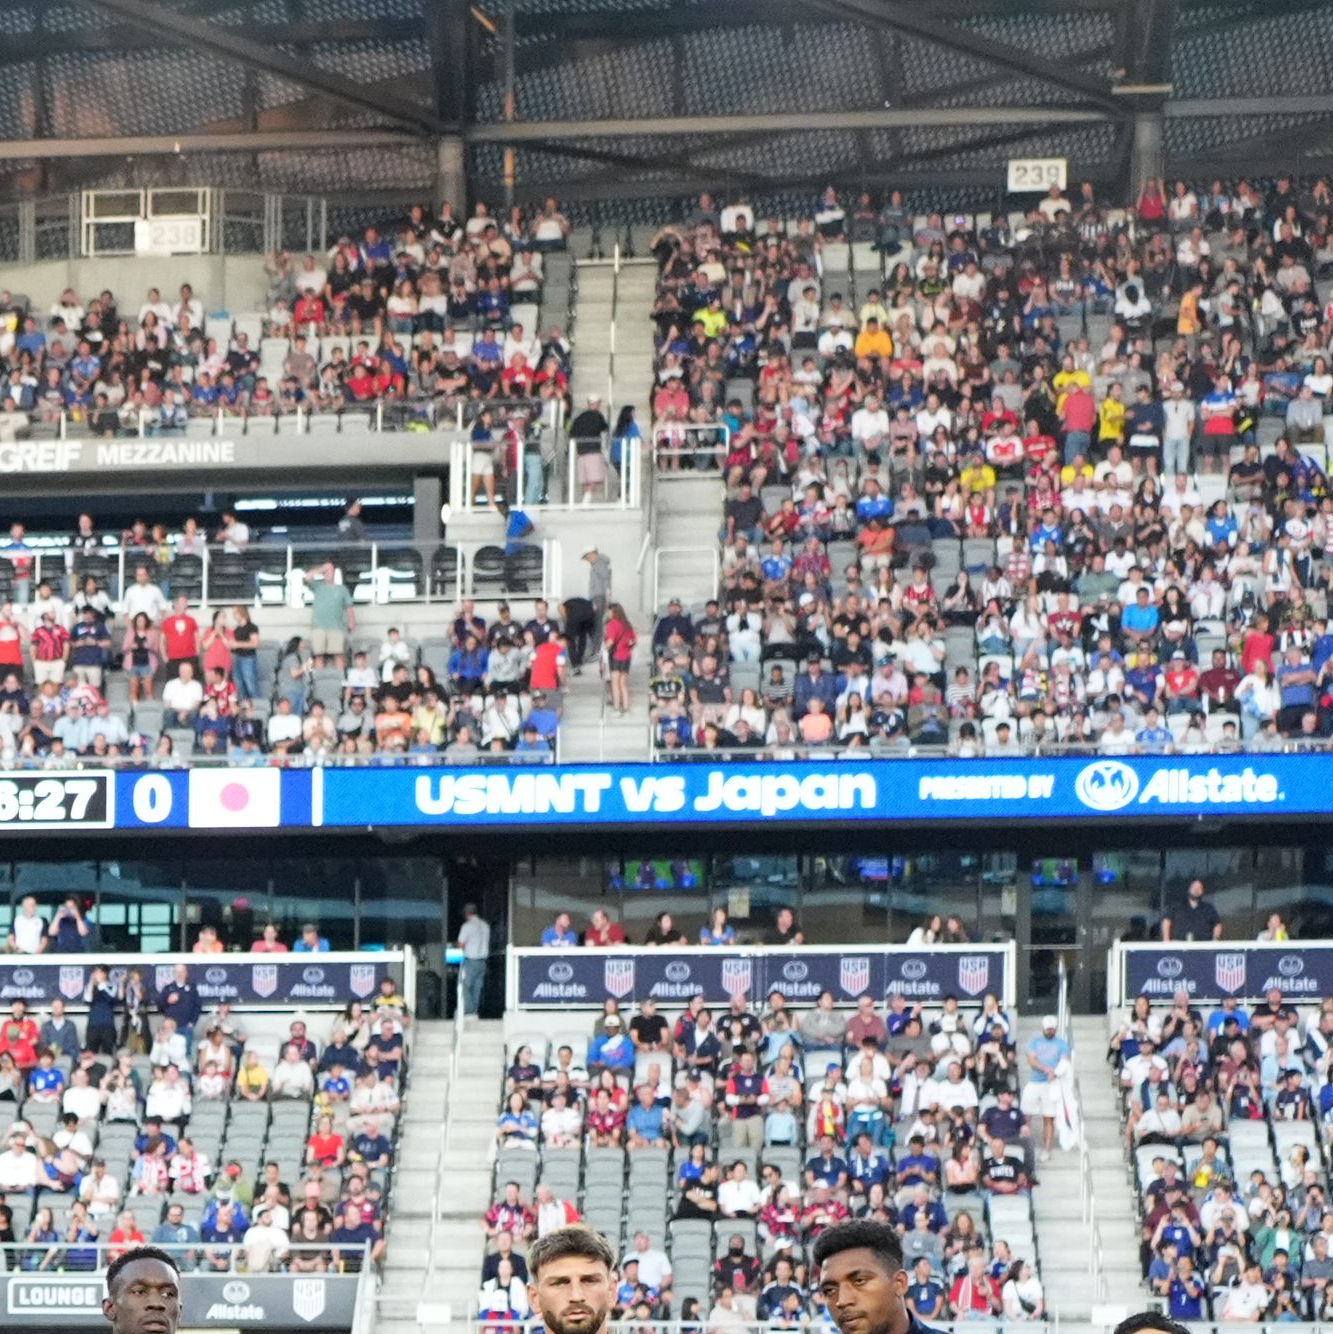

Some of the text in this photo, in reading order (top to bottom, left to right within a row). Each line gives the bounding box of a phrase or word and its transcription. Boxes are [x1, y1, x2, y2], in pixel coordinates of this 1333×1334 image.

[1015, 165, 1060, 185] 239
[154, 225, 196, 245] 238
[97, 441, 235, 465] MEZZANINE
[415, 771, 876, 816] USMNT vs Japan
[919, 775, 1054, 800] PRESENTED BY
[133, 775, 172, 823] 0
[290, 984, 334, 997] Allstate
[533, 982, 587, 997] Allstate
[649, 981, 703, 997] Allstate
[768, 981, 821, 996] Allstate
[886, 980, 940, 995] Allstate
[1141, 978, 1196, 993] Allstate
[1262, 976, 1318, 991] Allstate
[19, 1286, 97, 1306] LOUNGE
[206, 1304, 265, 1320] Allstate
